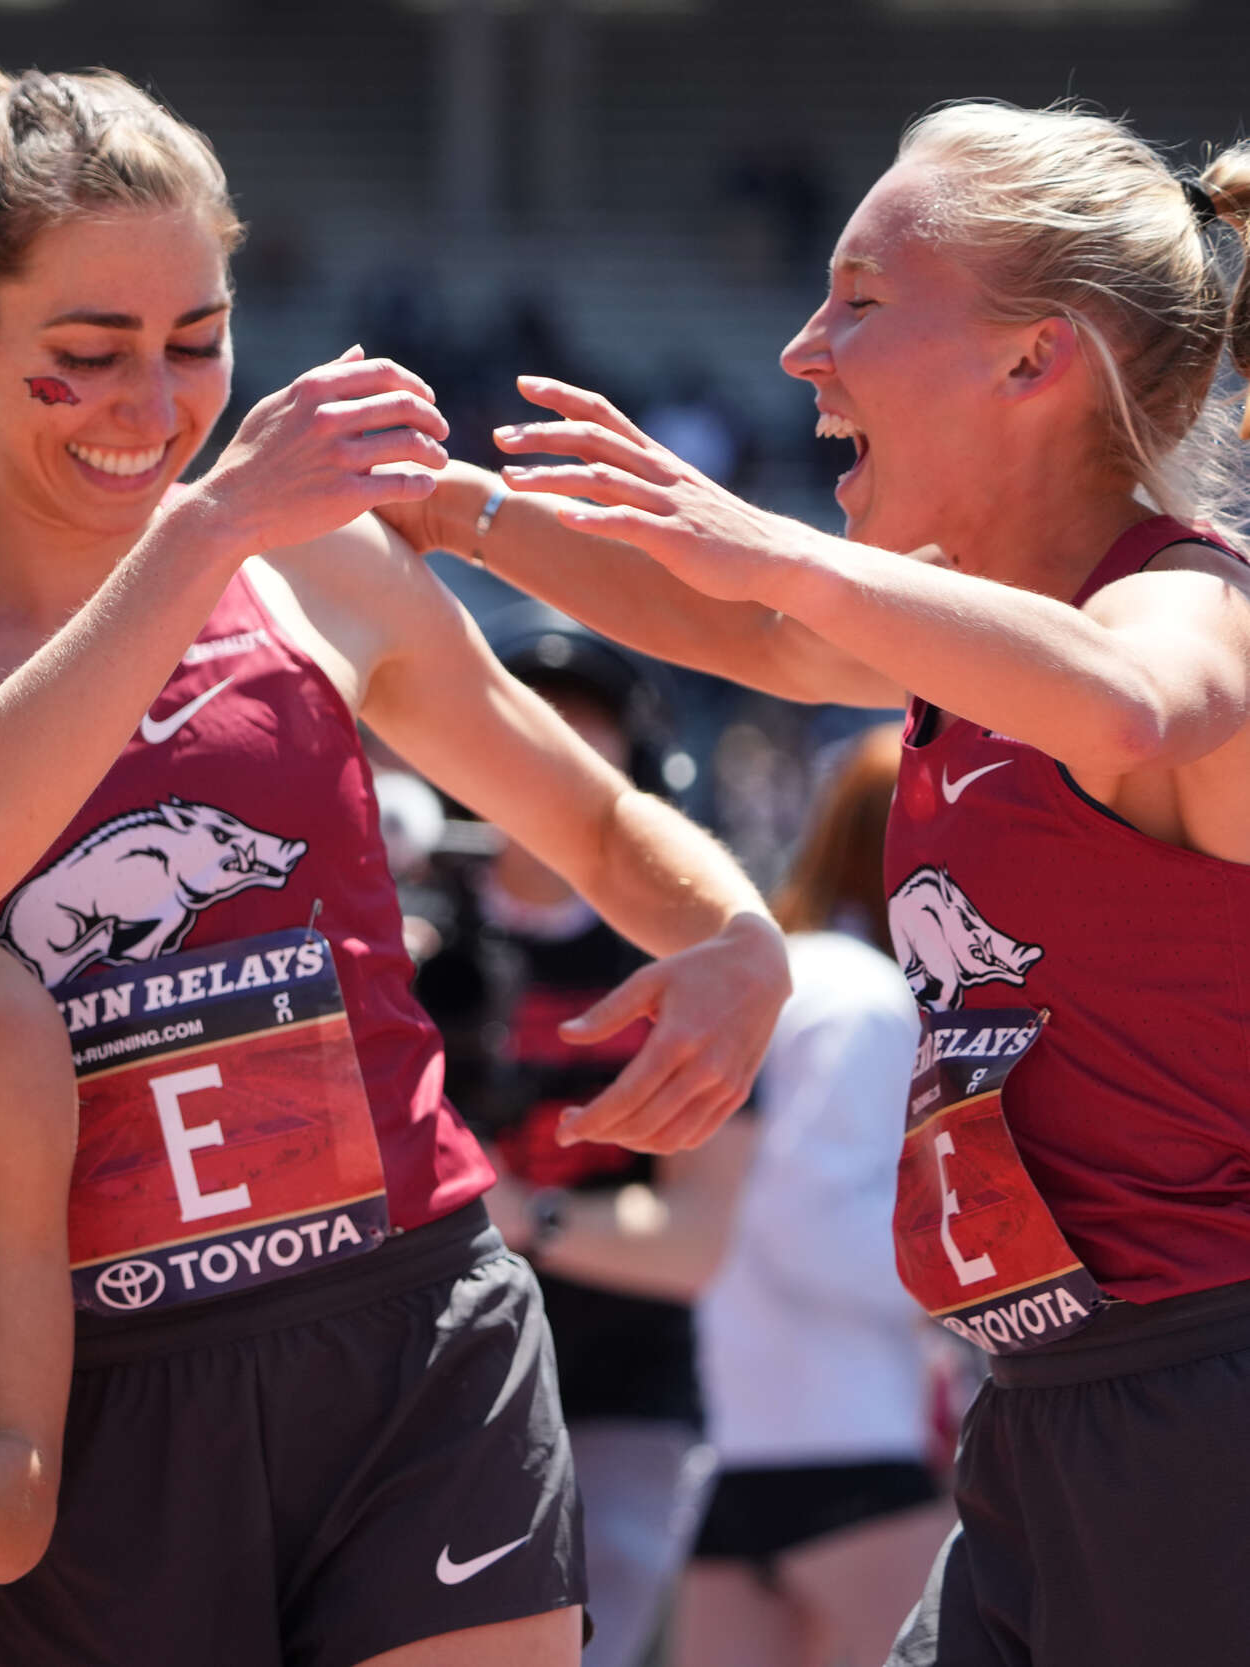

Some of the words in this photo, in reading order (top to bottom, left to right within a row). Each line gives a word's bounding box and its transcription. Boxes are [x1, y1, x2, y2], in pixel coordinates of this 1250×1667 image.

[57, 981, 135, 1033] NN
[143, 941, 325, 1012] RELAYS
[148, 1063, 252, 1223] E
[168, 1213, 363, 1291] TOYOTA
[967, 1286, 1091, 1356] TOYOTA
